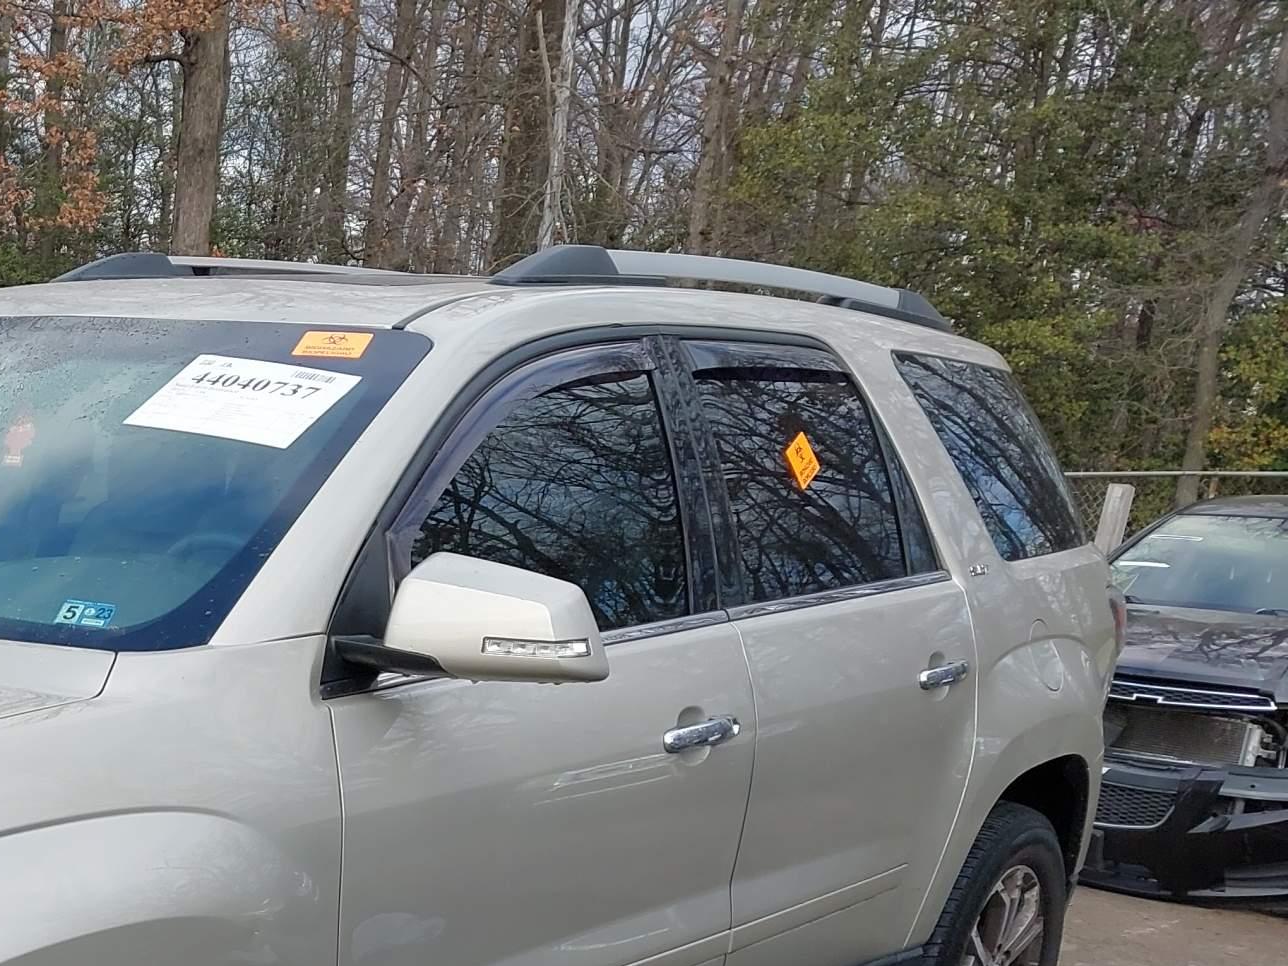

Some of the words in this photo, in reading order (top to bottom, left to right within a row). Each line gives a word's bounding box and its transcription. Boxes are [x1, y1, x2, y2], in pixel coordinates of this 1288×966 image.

[191, 371, 321, 399] 44040737
[62, 605, 79, 620] 5
[95, 607, 113, 620] 23
